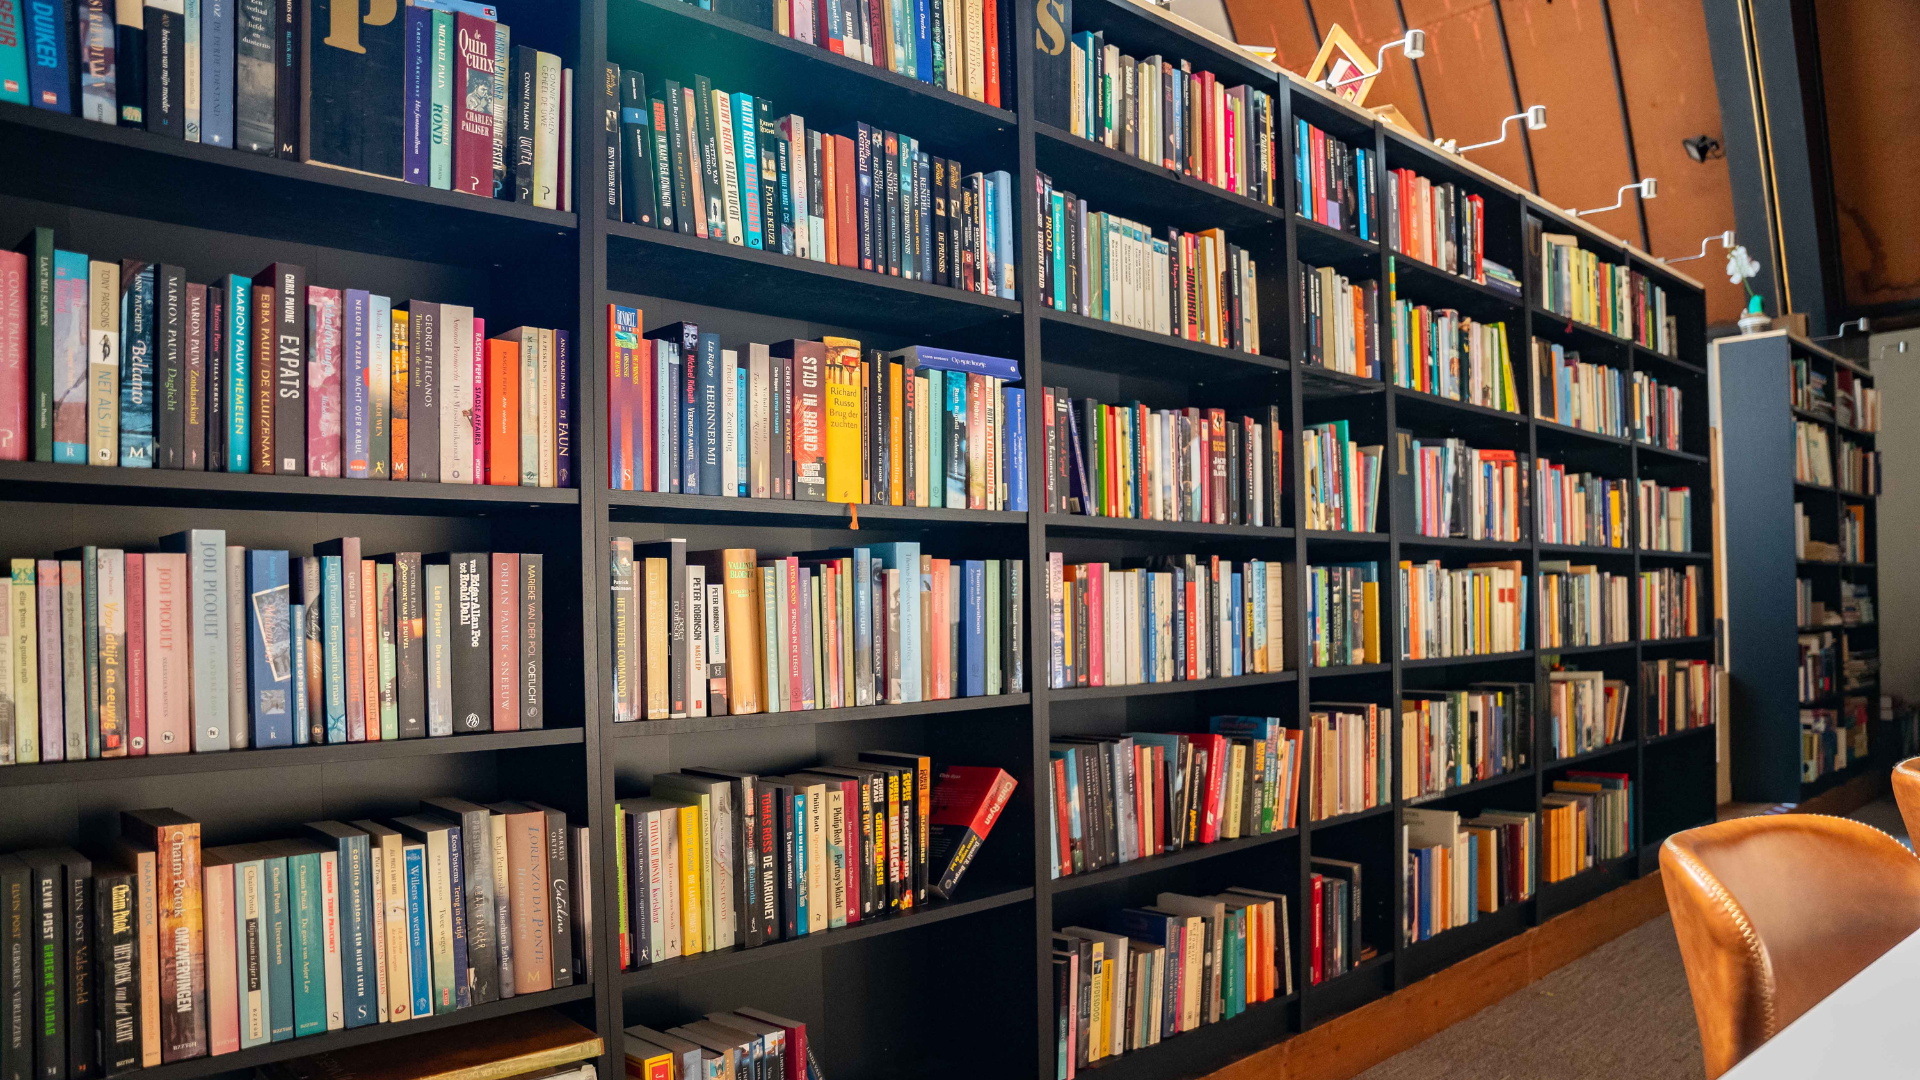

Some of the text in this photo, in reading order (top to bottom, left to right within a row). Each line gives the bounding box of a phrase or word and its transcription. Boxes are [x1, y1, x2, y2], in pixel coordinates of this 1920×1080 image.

[32, 2, 57, 68] DUIKER
[324, 0, 397, 54] P
[1035, 0, 1066, 56] S
[437, 23, 446, 89] MICHAEL PALIN
[432, 102, 443, 144] ROND
[443, 105, 449, 115] DE
[461, 121, 490, 137] PALLISER
[465, 110, 493, 125] CHARLES
[518, 136, 532, 165] LUCIFER
[720, 95, 740, 221] KATHY REICHS FATALE VLUCHT
[742, 100, 760, 232] KATHY REICHS FATALE GEHEIMEN
[1186, 266, 1197, 325] GOMORRA
[166, 276, 177, 411] MARION PAUW Daglicht
[279, 274, 299, 399] CHRIS PAVONE EXPATS
[190, 296, 200, 424] MARION PAUW Zondaarskind
[235, 286, 245, 434] MARION PAUW HEMELEN
[424, 314, 433, 408] GEORGE PELECANOS
[802, 357, 817, 387] STAD
[725, 363, 734, 452] Trudi Rijks Zeetijding
[802, 393, 817, 406] IN
[830, 386, 857, 397] Richard
[834, 397, 855, 407] Russo
[906, 368, 914, 409] STOUT
[560, 410, 566, 418] DE
[705, 385, 716, 465] HERINNER MIJ
[803, 411, 818, 451] BRAND
[830, 421, 858, 429] zuchten
[559, 422, 568, 456] FAUN
[1395, 433, 1411, 476] T
[157, 567, 171, 595] JODI
[200, 543, 218, 639] JODI PICOULT
[469, 574, 480, 602] Edgar
[693, 577, 701, 601] PETER
[105, 602, 118, 631] Voor
[159, 600, 172, 651] PICOULT
[471, 602, 480, 629] Allan
[501, 563, 510, 710] ORHAN PAMUK SNEEUW
[693, 604, 702, 640] ROBINSON
[104, 634, 118, 666] altijd
[471, 630, 480, 647] Poe
[617, 597, 627, 697] HET TWEEDE COMMANDO
[792, 645, 798, 653] DE
[106, 669, 116, 683] en
[528, 661, 536, 704] VOETLICHT
[103, 687, 117, 730] eeuwig
[984, 781, 1013, 825] Chris Ryan
[557, 828, 565, 861] MARKUS
[651, 847, 658, 857] DE
[761, 792, 774, 920] TOMAS ROSS DE MARIONET
[833, 807, 843, 909] Philip Roth Portnoy's klacht
[652, 859, 660, 884] ROSNAY
[171, 831, 192, 1013] Chaim Potok OMZWERVINGEN
[411, 865, 422, 947] Willens en wetens
[553, 878, 567, 934] Catalina
[42, 879, 55, 1035] ELVIN POST GROENE VRIJDAG
[75, 879, 88, 1004] ELVIN POST Vals beeld
